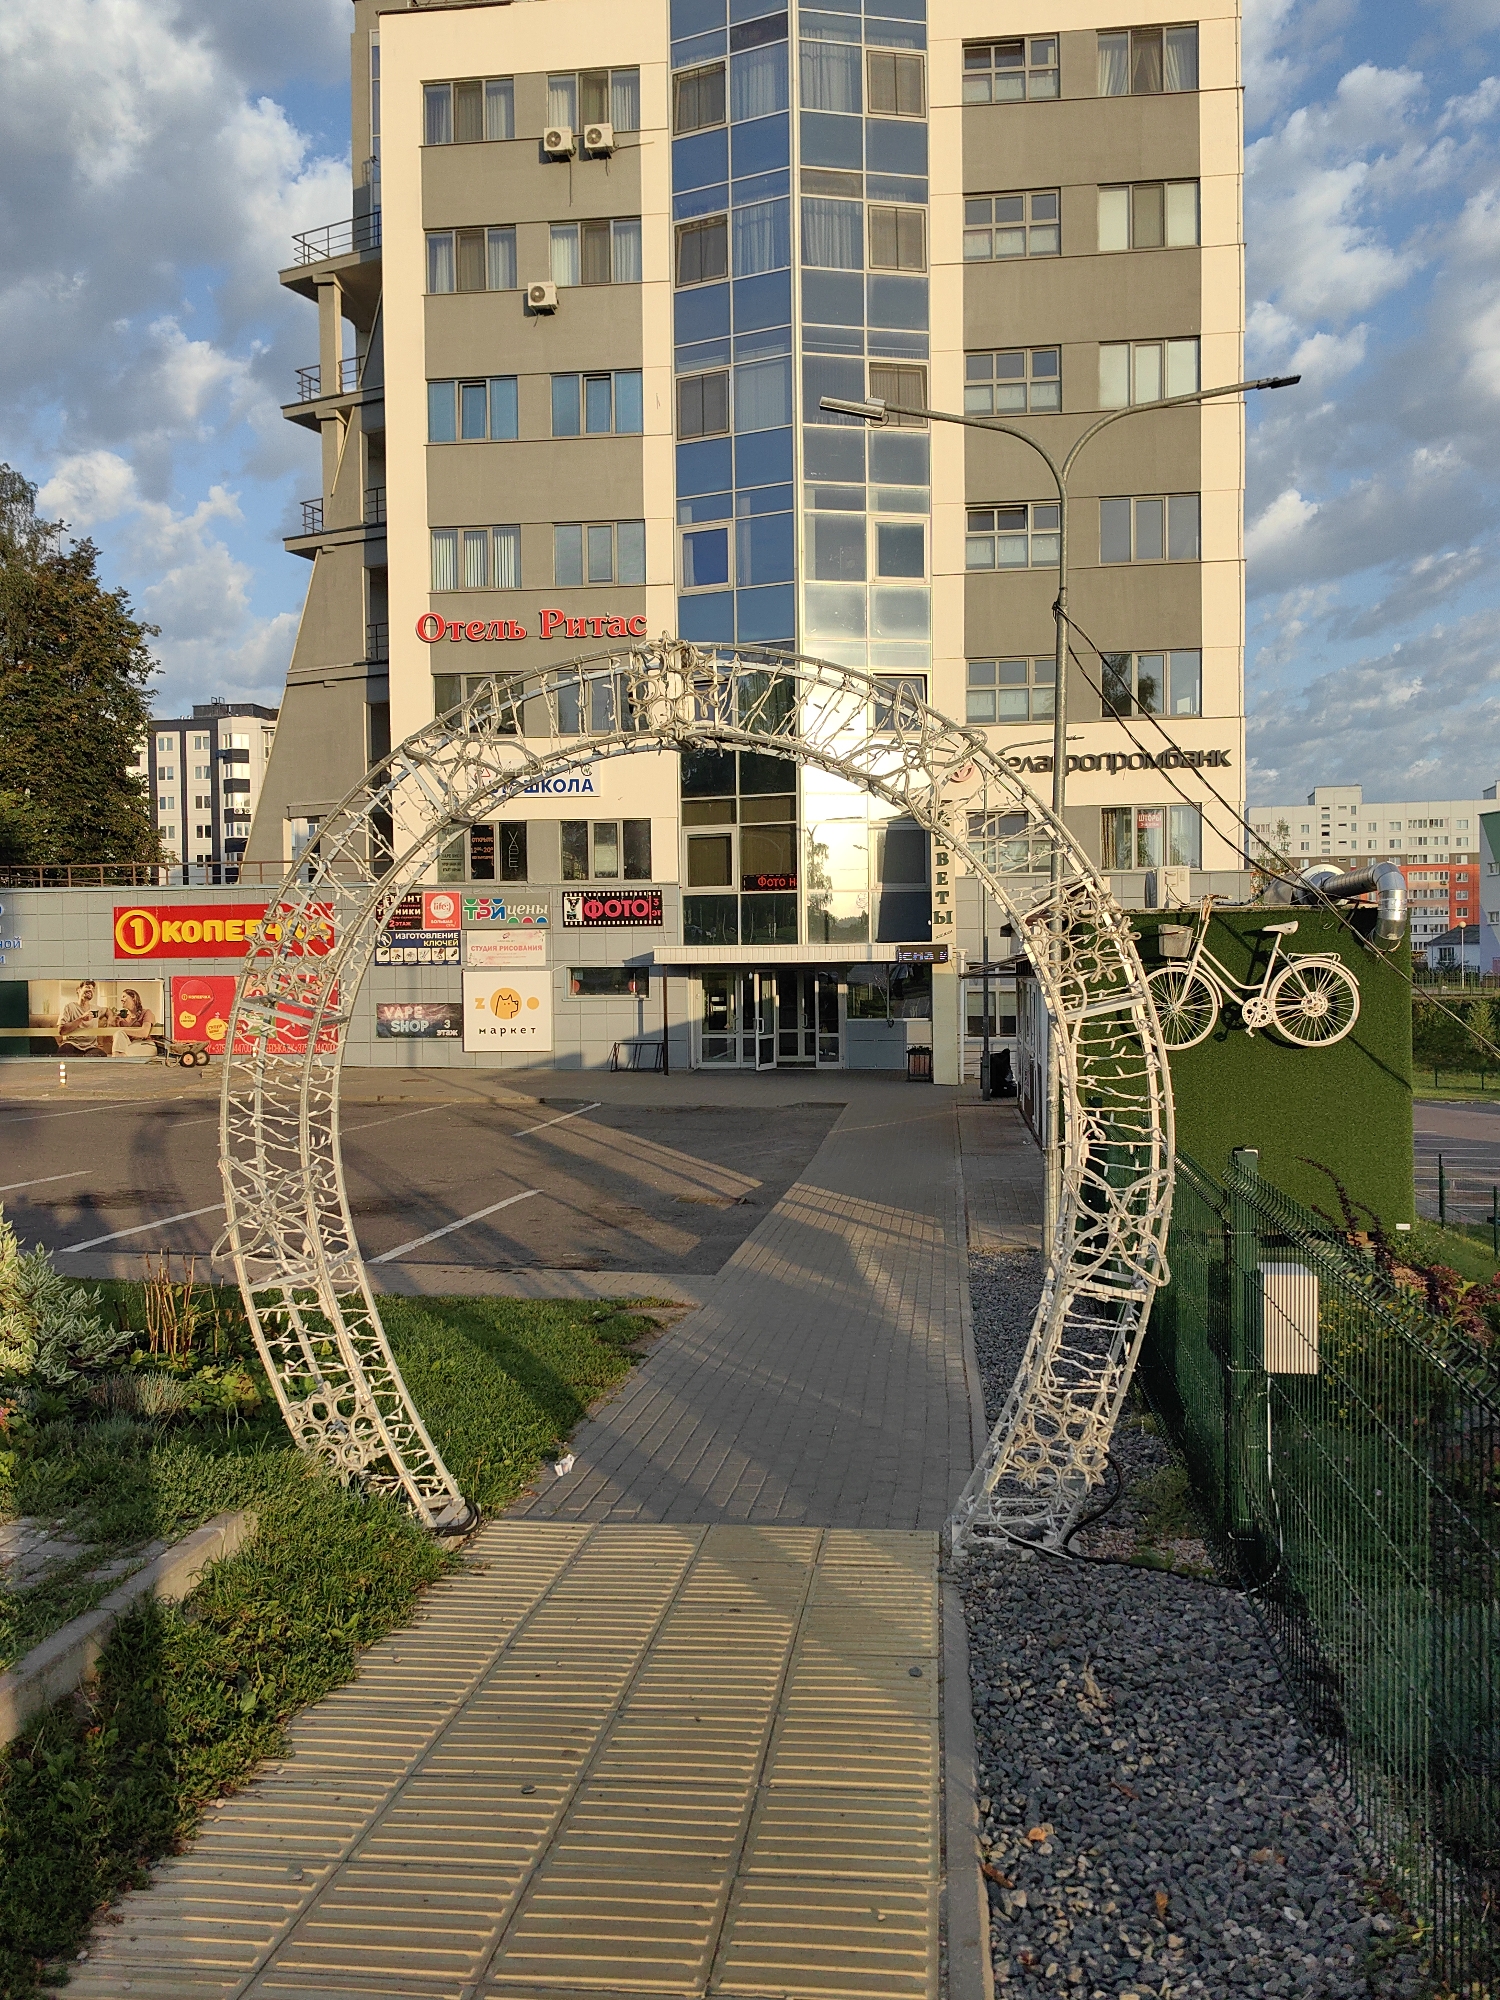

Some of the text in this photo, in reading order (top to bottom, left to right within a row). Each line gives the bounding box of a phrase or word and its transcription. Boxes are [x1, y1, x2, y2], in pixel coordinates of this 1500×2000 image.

[416, 608, 648, 642] Отель Ритас
[988, 747, 1232, 775] еларопромбанк
[757, 875, 786, 887] Фото
[378, 895, 422, 903] ЕМОНТ
[376, 908, 421, 916] ТНИКИ
[463, 904, 548, 921] ТРИ цены
[584, 899, 649, 919] ФОТО
[395, 932, 459, 940] ИЗГОТОВЛЕНИЕ
[423, 938, 459, 947] КЛЮЧЕЙ
[384, 1006, 423, 1019] VAPE
[390, 1019, 430, 1033] SHOP
[443, 1019, 451, 1029] 3
[478, 1026, 537, 1037] маркет
